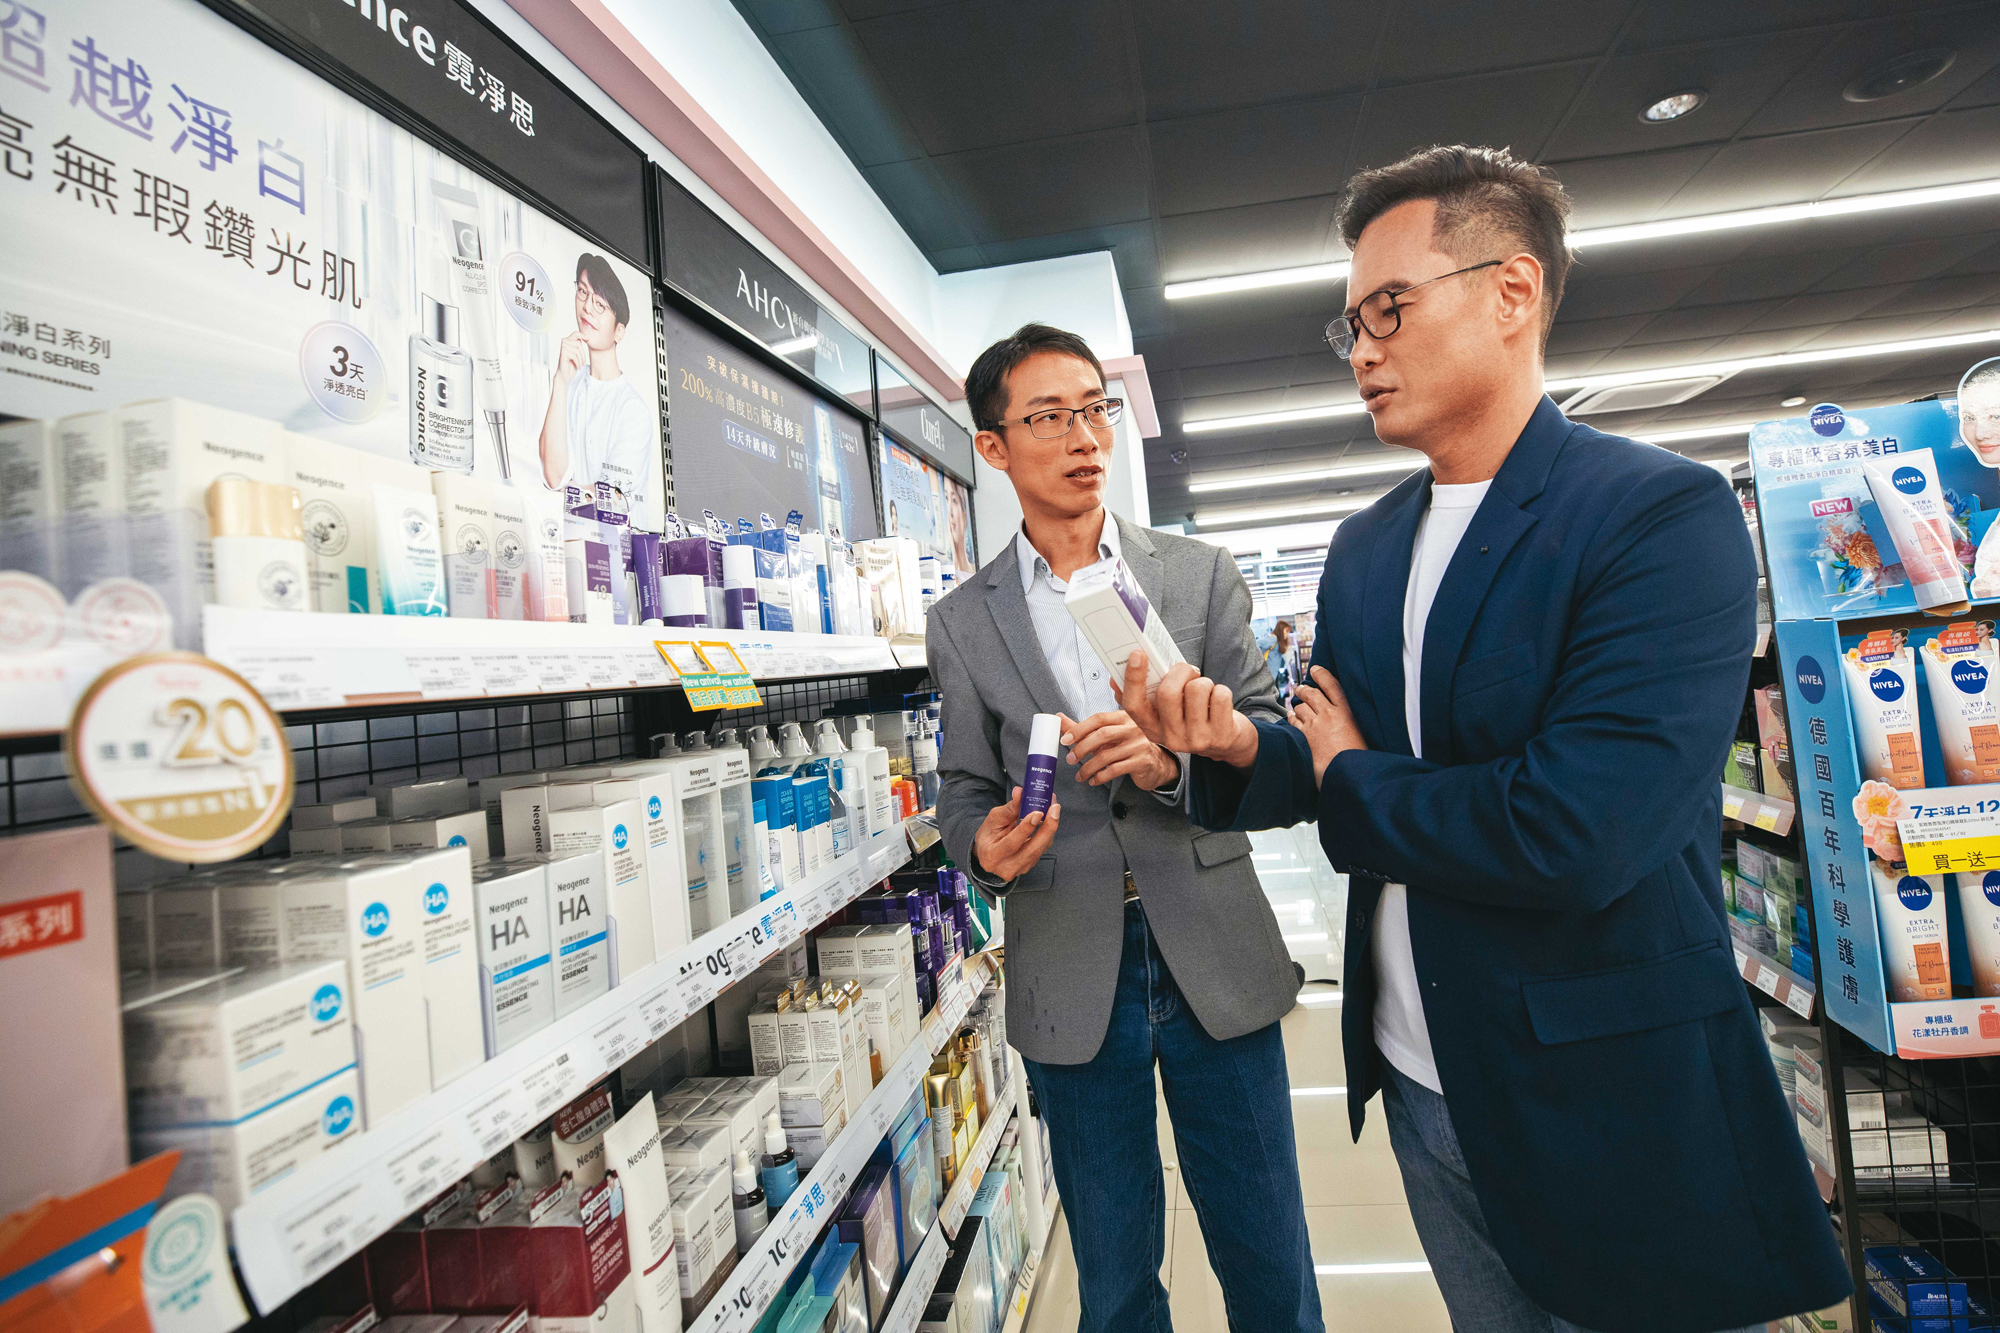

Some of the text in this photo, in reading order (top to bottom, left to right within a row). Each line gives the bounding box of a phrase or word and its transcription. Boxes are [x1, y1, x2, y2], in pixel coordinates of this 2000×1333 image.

[343, 0, 535, 137] nce 霓淨思
[515, 270, 545, 303] 91%
[736, 268, 787, 330] AHC
[42, 350, 100, 375] SERIES
[330, 345, 364, 383] 3天
[416, 366, 427, 453] Neogence
[1813, 416, 1842, 425] NIVEA
[920, 408, 941, 451] Curél
[1896, 475, 1924, 486] NIVEA
[455, 504, 488, 516] Neogence
[1814, 501, 1849, 515] NEW
[494, 512, 523, 523] Neogence
[681, 676, 698, 687] New
[722, 678, 735, 687] ew
[1798, 674, 1823, 686] NIVEA
[1954, 672, 1986, 682] NIVEA
[1872, 680, 1901, 690] NIVEA
[727, 759, 743, 768] Neogence
[1031, 766, 1053, 774] Neogence
[690, 766, 709, 777] Neogence
[648, 802, 661, 816] HA
[613, 831, 628, 845] HA
[1932, 851, 2000, 871] 買一送一
[557, 877, 590, 893] Neogence
[1985, 885, 2000, 895] NIV
[425, 891, 447, 910] HA
[1899, 889, 1930, 898] NIVEA
[489, 896, 528, 916] Neogence
[558, 894, 591, 926] HA
[1906, 923, 1940, 934] BRIGHT
[1908, 918, 1935, 926] EXTRA
[491, 915, 530, 951] HA
[561, 950, 590, 967] HYALURONIC
[561, 965, 589, 982] ESSENCE
[495, 975, 529, 995] HYALURONIC
[496, 992, 528, 1012] ESSENCE
[1924, 1014, 1954, 1025] 專櫃級
[1912, 1026, 1969, 1038] 花漾牡丹香調
[577, 1142, 604, 1169] Neoge
[627, 1131, 661, 1169] Neogence
[590, 1221, 618, 1252] MANDELIC
[592, 1238, 623, 1273] CLEANSING
